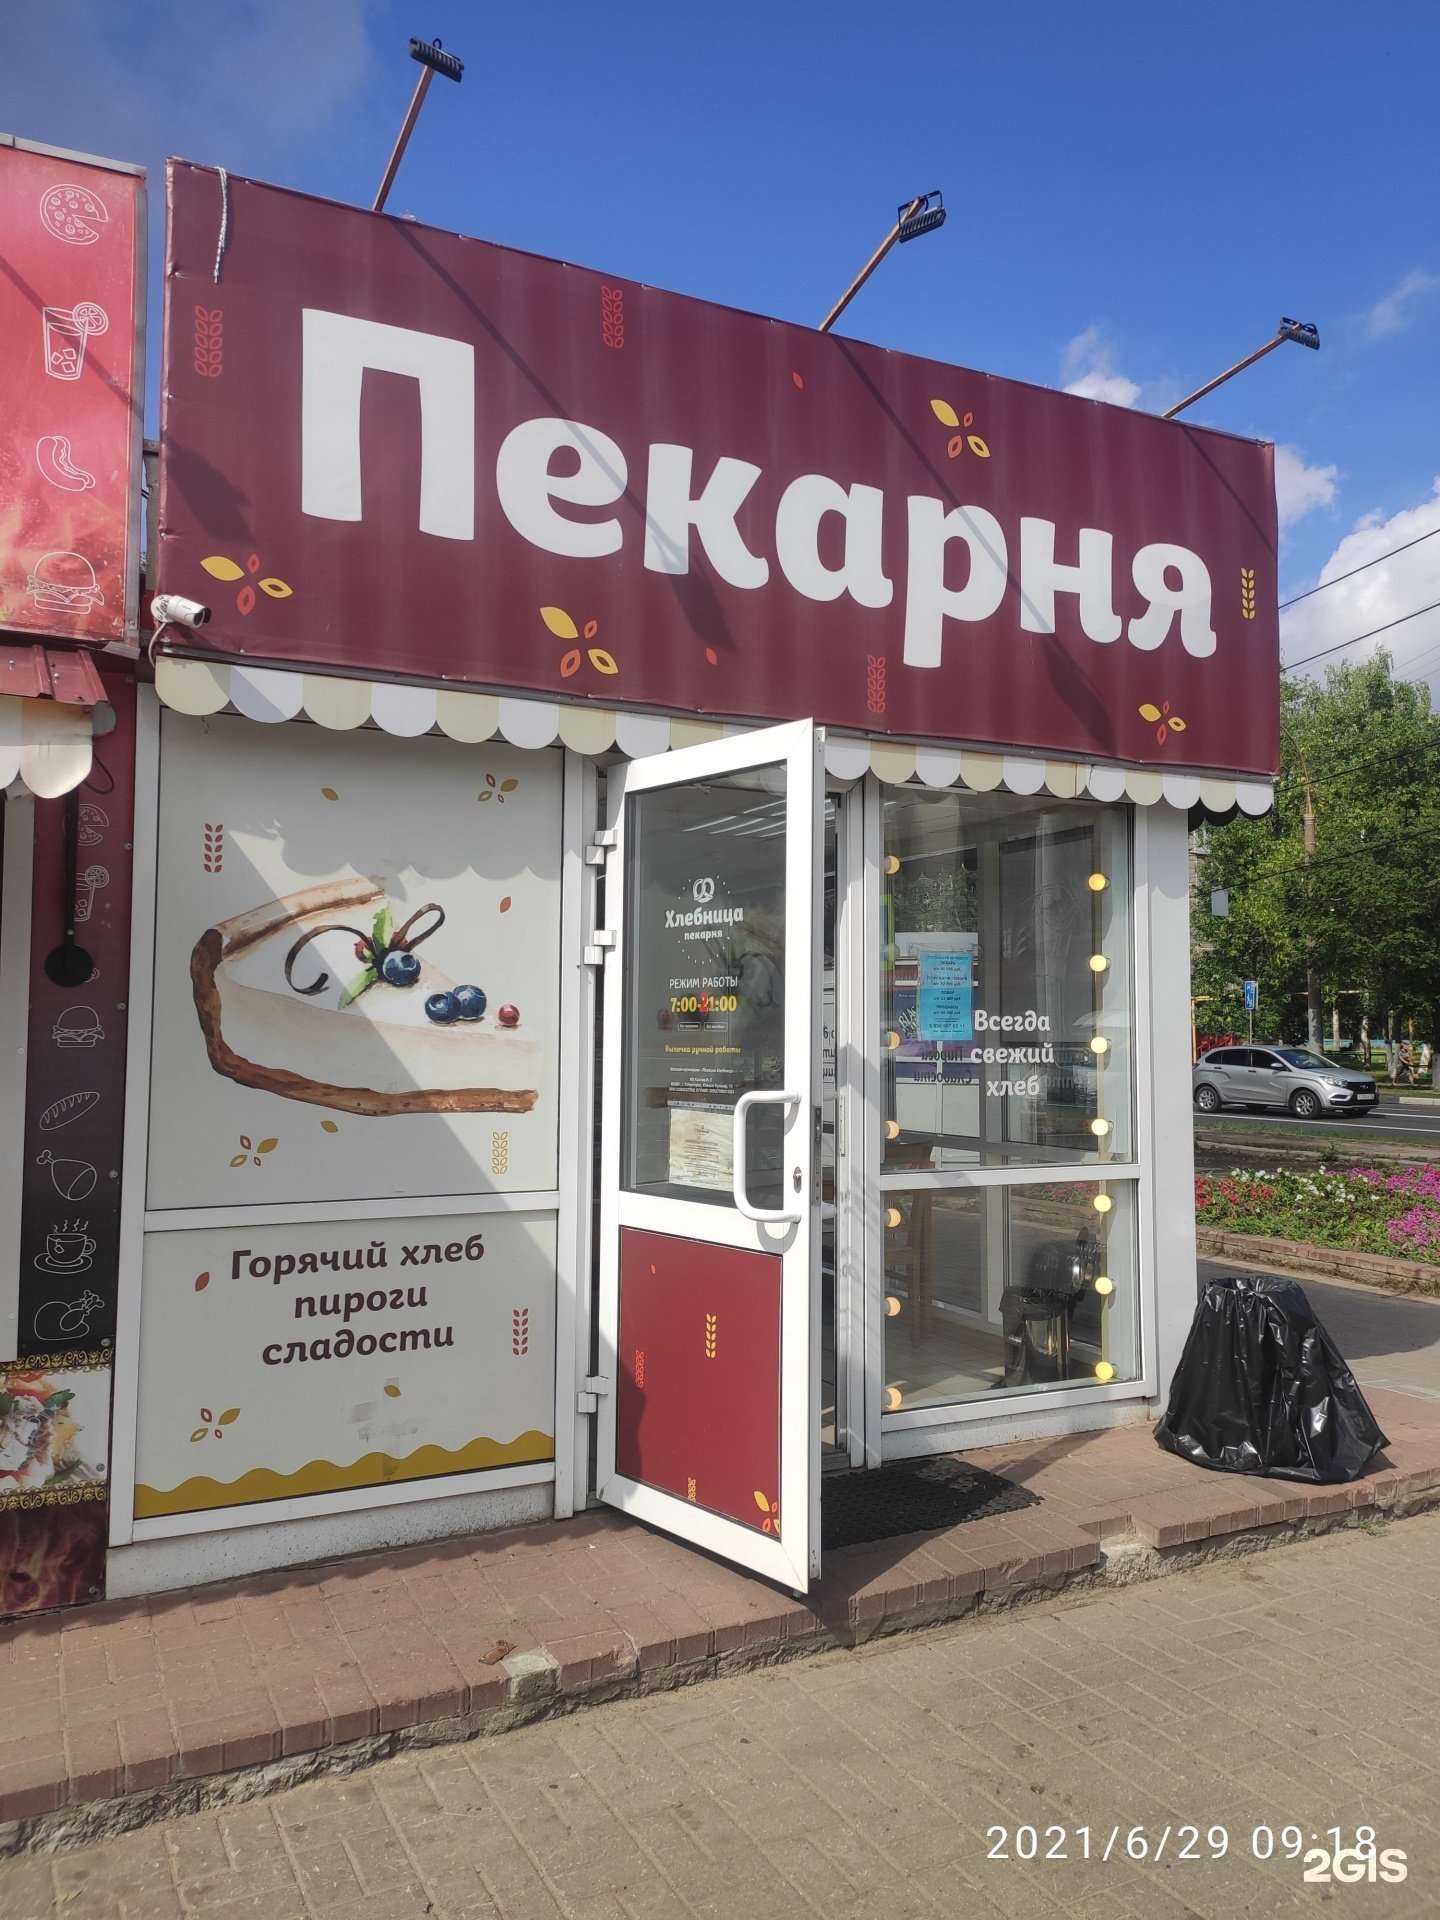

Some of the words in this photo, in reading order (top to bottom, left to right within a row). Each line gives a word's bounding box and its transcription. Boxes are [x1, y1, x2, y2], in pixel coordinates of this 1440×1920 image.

[302, 307, 1218, 669] Пекарня
[664, 906, 745, 929] Хлебница
[684, 929, 723, 942] пекарня
[669, 977, 700, 989] РЕЖИМ
[702, 975, 738, 988] РАБОТЫ
[670, 994, 737, 1013] 7:00-21:00
[974, 1009, 1051, 1031] Всегда
[970, 1042, 1055, 1064] свежий
[986, 1074, 1040, 1097] хлеб
[231, 1240, 388, 1285] Горячий
[400, 1233, 485, 1267] хлеб
[294, 1286, 428, 1323] пироги
[261, 1326, 455, 1366] сладости
